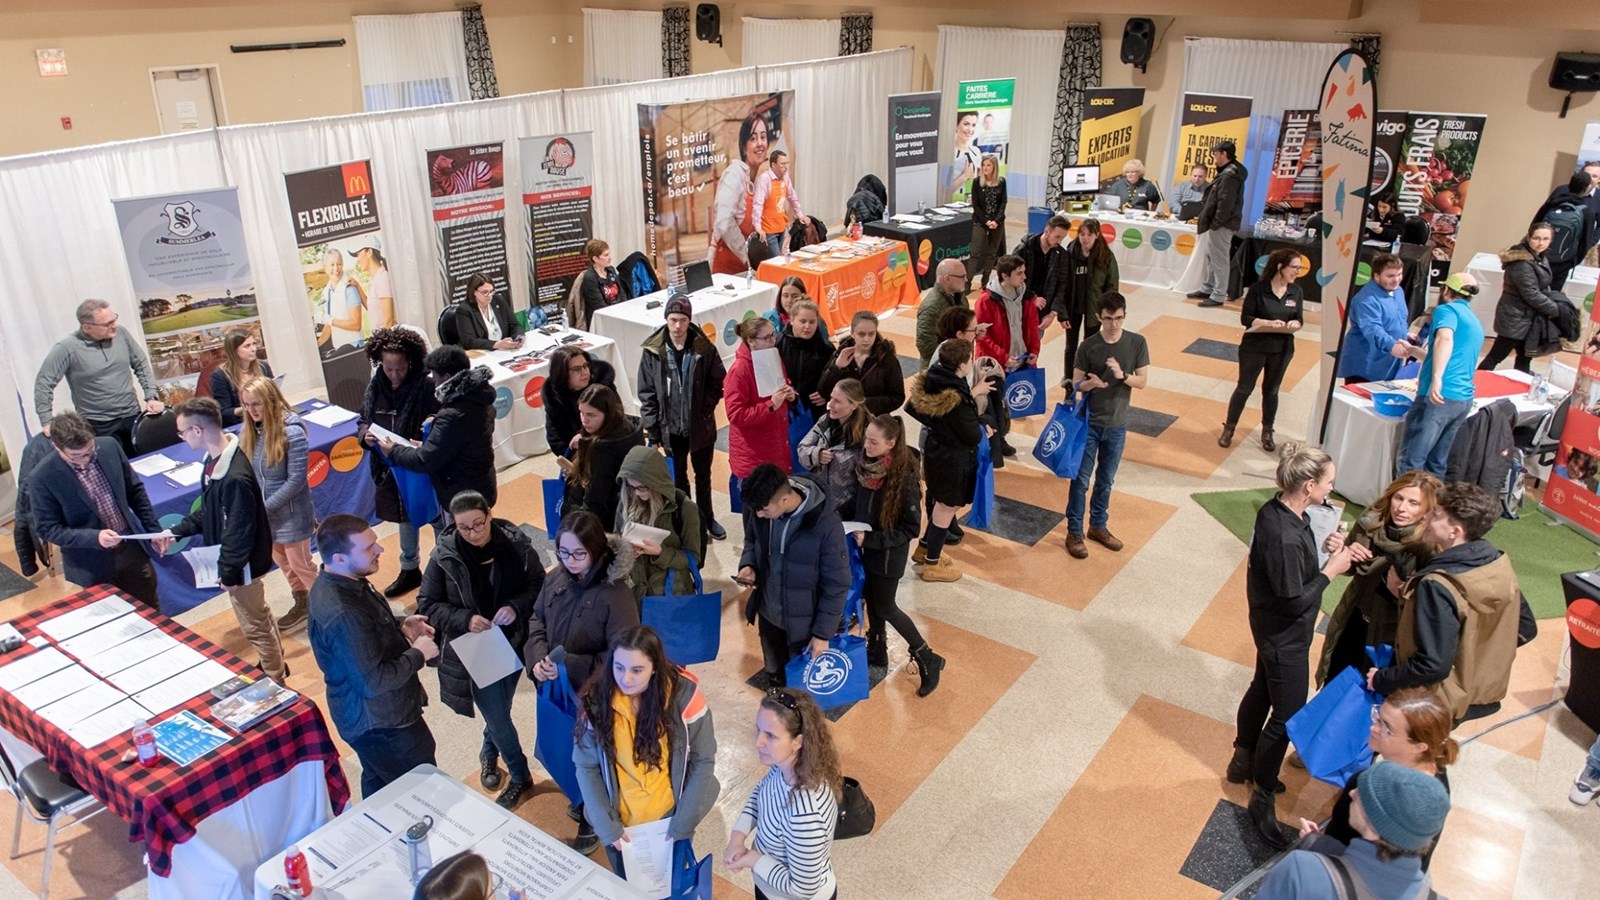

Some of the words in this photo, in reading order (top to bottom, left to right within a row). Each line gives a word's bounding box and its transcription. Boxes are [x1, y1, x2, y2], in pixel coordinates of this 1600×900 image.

[966, 84, 988, 92] FAITES
[965, 91, 997, 100] CARRIÈRE
[903, 106, 931, 114] Desjardins
[1442, 120, 1465, 130] FRESH
[665, 134, 678, 147] Se
[681, 130, 708, 144] bâtir
[895, 130, 903, 140] En
[903, 126, 938, 140] mouvement
[1088, 125, 1132, 155] EXPERTS
[1188, 133, 1197, 146] TA
[1323, 121, 1369, 157] Fatima
[1440, 130, 1478, 140] PRODUCTS
[895, 141, 909, 151] pour
[909, 140, 923, 148] vous
[1405, 117, 1440, 166] FRAIS
[665, 149, 680, 159] un
[683, 140, 717, 156] avenir
[909, 147, 924, 156] vous!
[1098, 144, 1130, 165] LOCATION
[1185, 147, 1192, 163] A
[666, 153, 728, 174] prometteur,
[667, 171, 690, 185] c'est
[643, 133, 656, 256] homedepot.ca/emplois
[668, 185, 695, 198] beau
[298, 196, 370, 229] FLEXIBILITÉ
